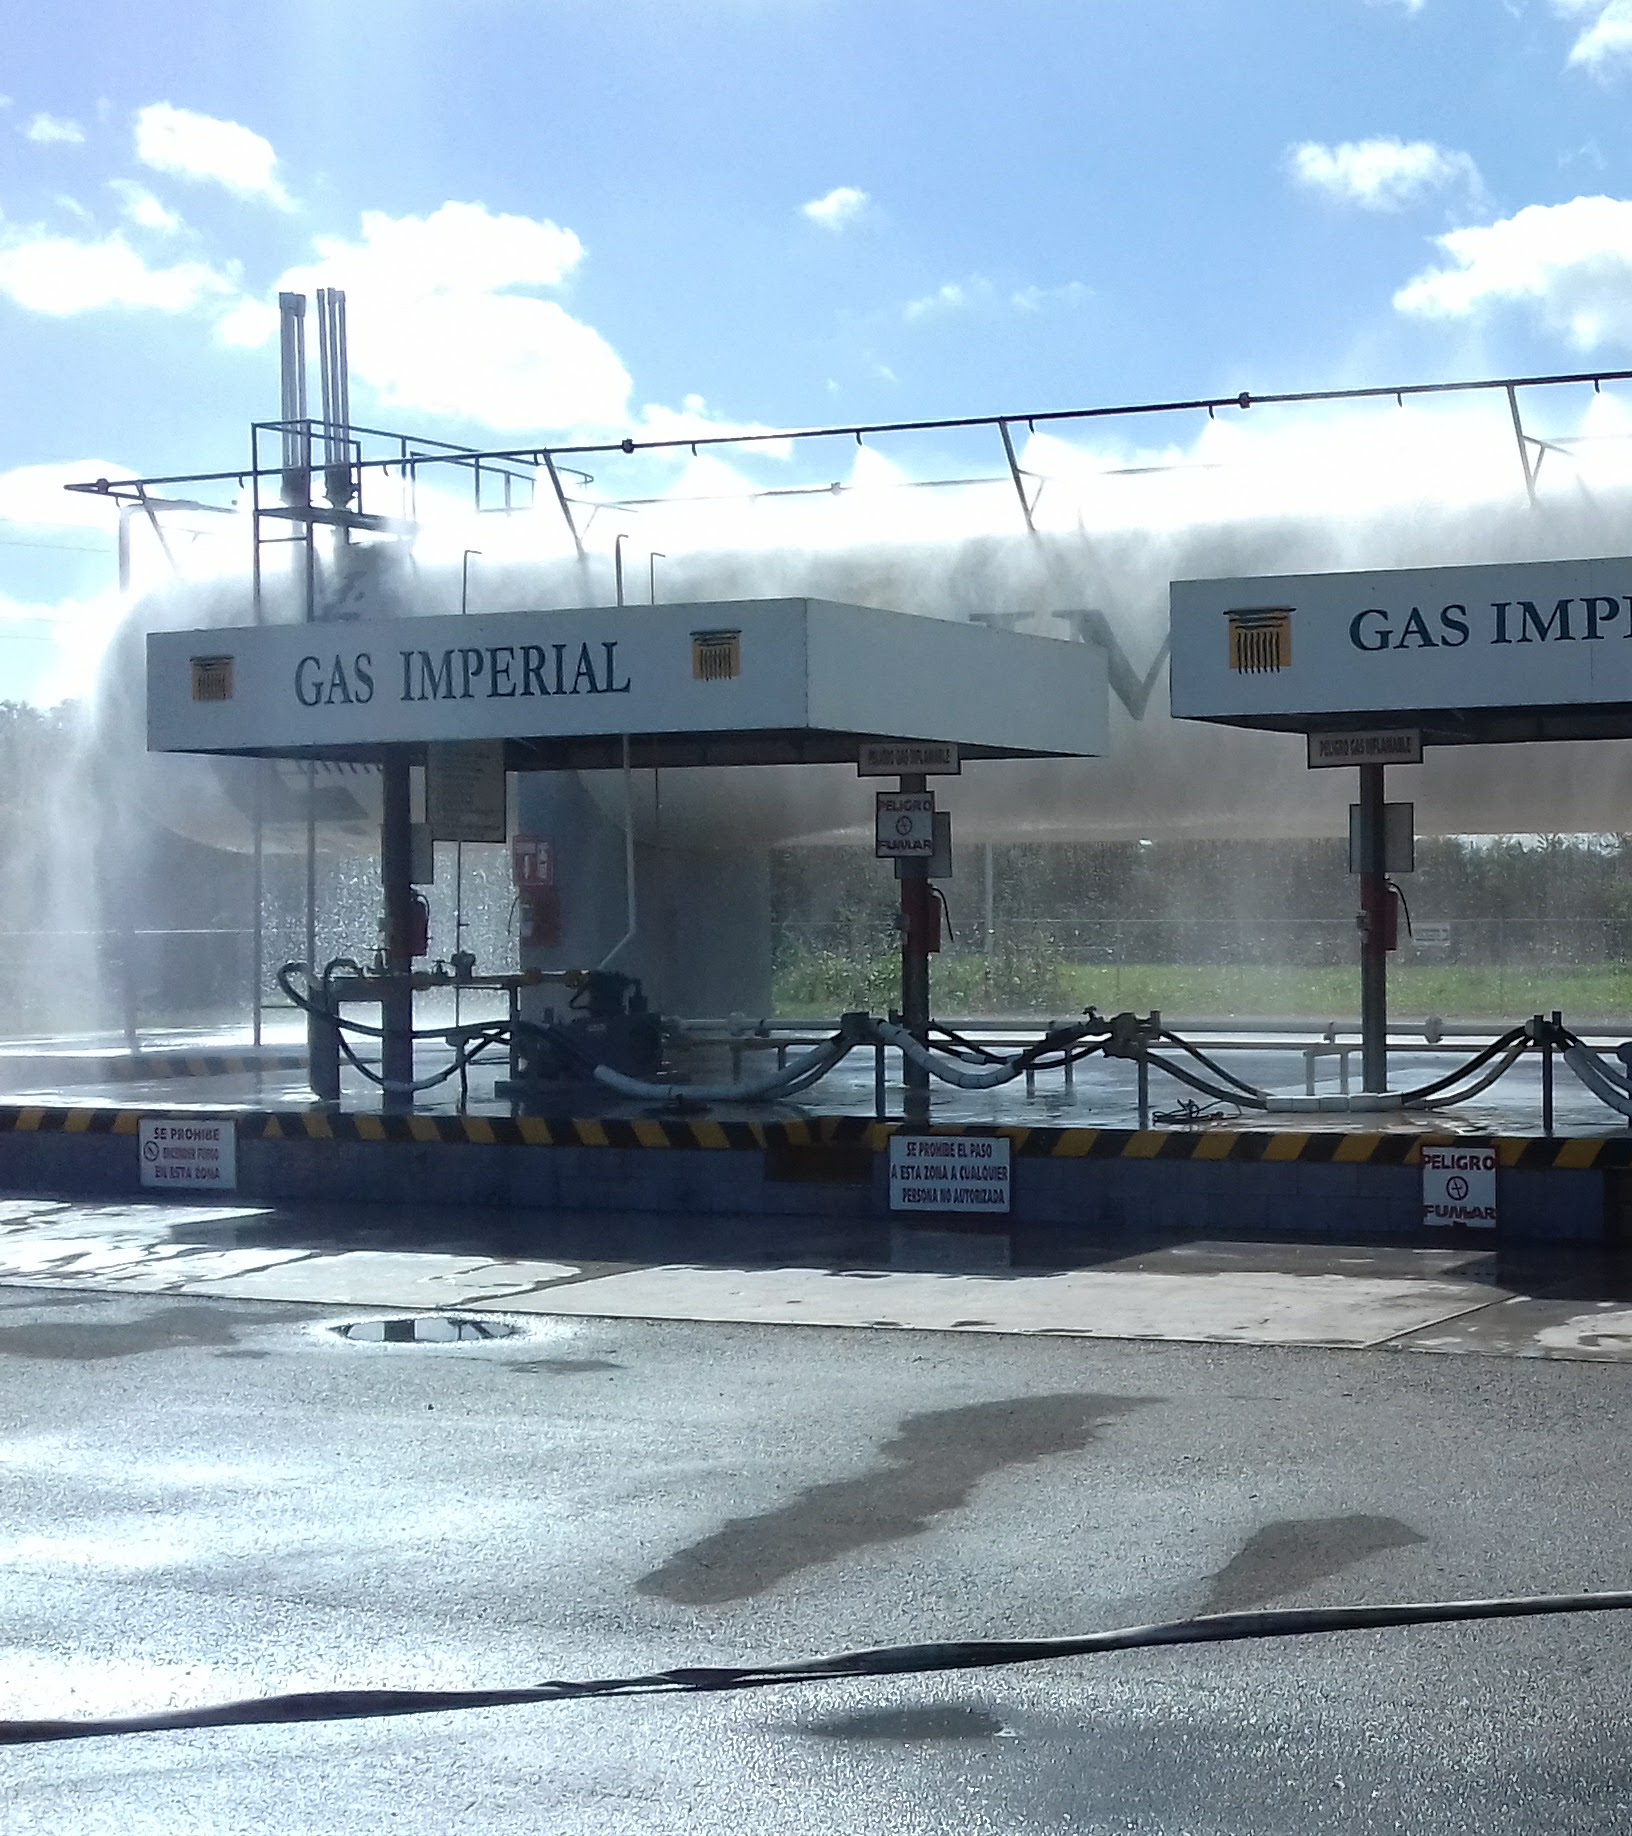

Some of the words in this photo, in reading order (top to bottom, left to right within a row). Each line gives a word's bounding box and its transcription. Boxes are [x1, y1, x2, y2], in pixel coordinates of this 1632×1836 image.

[1349, 604, 1470, 651] GAS
[294, 653, 375, 707] GAS
[400, 641, 631, 702] IMPERIAL
[154, 1127, 167, 1140] SE
[170, 1128, 220, 1141] PROHIBE
[907, 1142, 917, 1158] SE
[919, 1142, 955, 1158] PROHIBE
[957, 1143, 967, 1158] EL
[970, 1143, 992, 1158] PASO
[1422, 1154, 1495, 1171] PELIGRO
[891, 1163, 898, 1180] A
[900, 1165, 922, 1180] ESTA
[924, 1165, 948, 1180] ZONA
[950, 1165, 957, 1180] A
[959, 1165, 1008, 1181] CUALQUIER
[902, 1187, 938, 1203] PERSONA
[940, 1188, 951, 1204] NO
[953, 1187, 1005, 1204] AUTORIZADA
[1424, 1204, 1496, 1219] FUMAR
